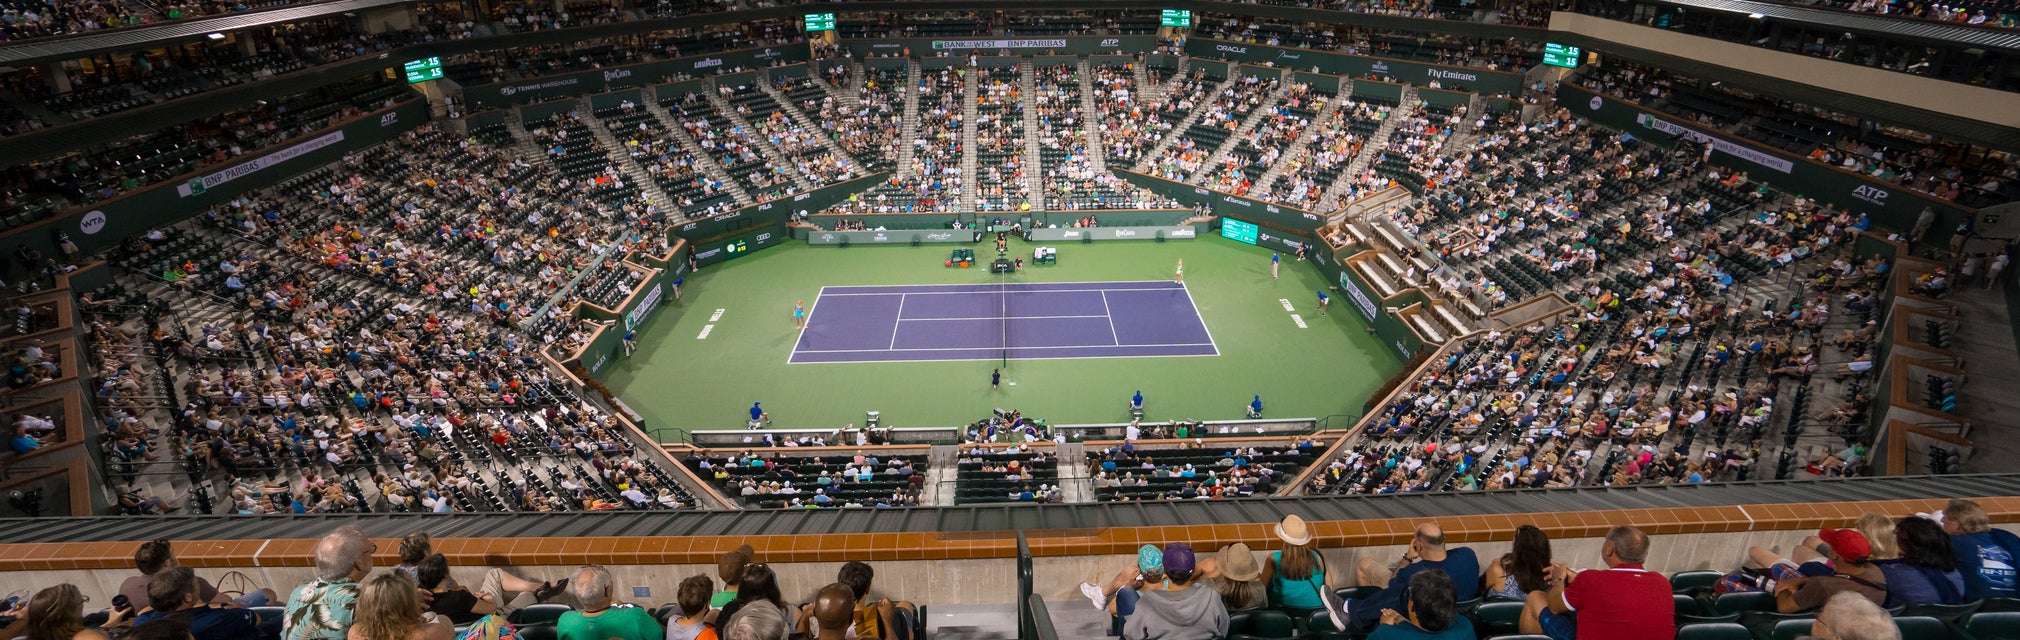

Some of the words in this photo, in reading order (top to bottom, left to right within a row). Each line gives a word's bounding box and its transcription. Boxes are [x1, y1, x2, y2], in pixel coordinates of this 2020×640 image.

[1216, 44, 1247, 54] ORACLE
[1568, 46, 1578, 55] 15
[428, 57, 438, 66] 15
[1566, 58, 1576, 66] 15
[431, 68, 442, 76] 15
[1428, 68, 1442, 78] Fly
[1443, 70, 1476, 81] Emirates
[517, 84, 540, 92] TENNIS
[541, 78, 578, 88] WAREHOUSE
[382, 112, 396, 124] ATP
[1654, 120, 1668, 130] BNP
[205, 174, 222, 186] BNP
[225, 161, 259, 179] PARIBAS
[1852, 184, 1888, 199] ATP
[758, 203, 772, 211] FILA
[1230, 197, 1251, 207] Barracuda
[714, 211, 740, 222] ORACLE
[1302, 212, 1318, 221] WTA
[82, 216, 104, 228] WTA
[684, 222, 696, 230] ATP
